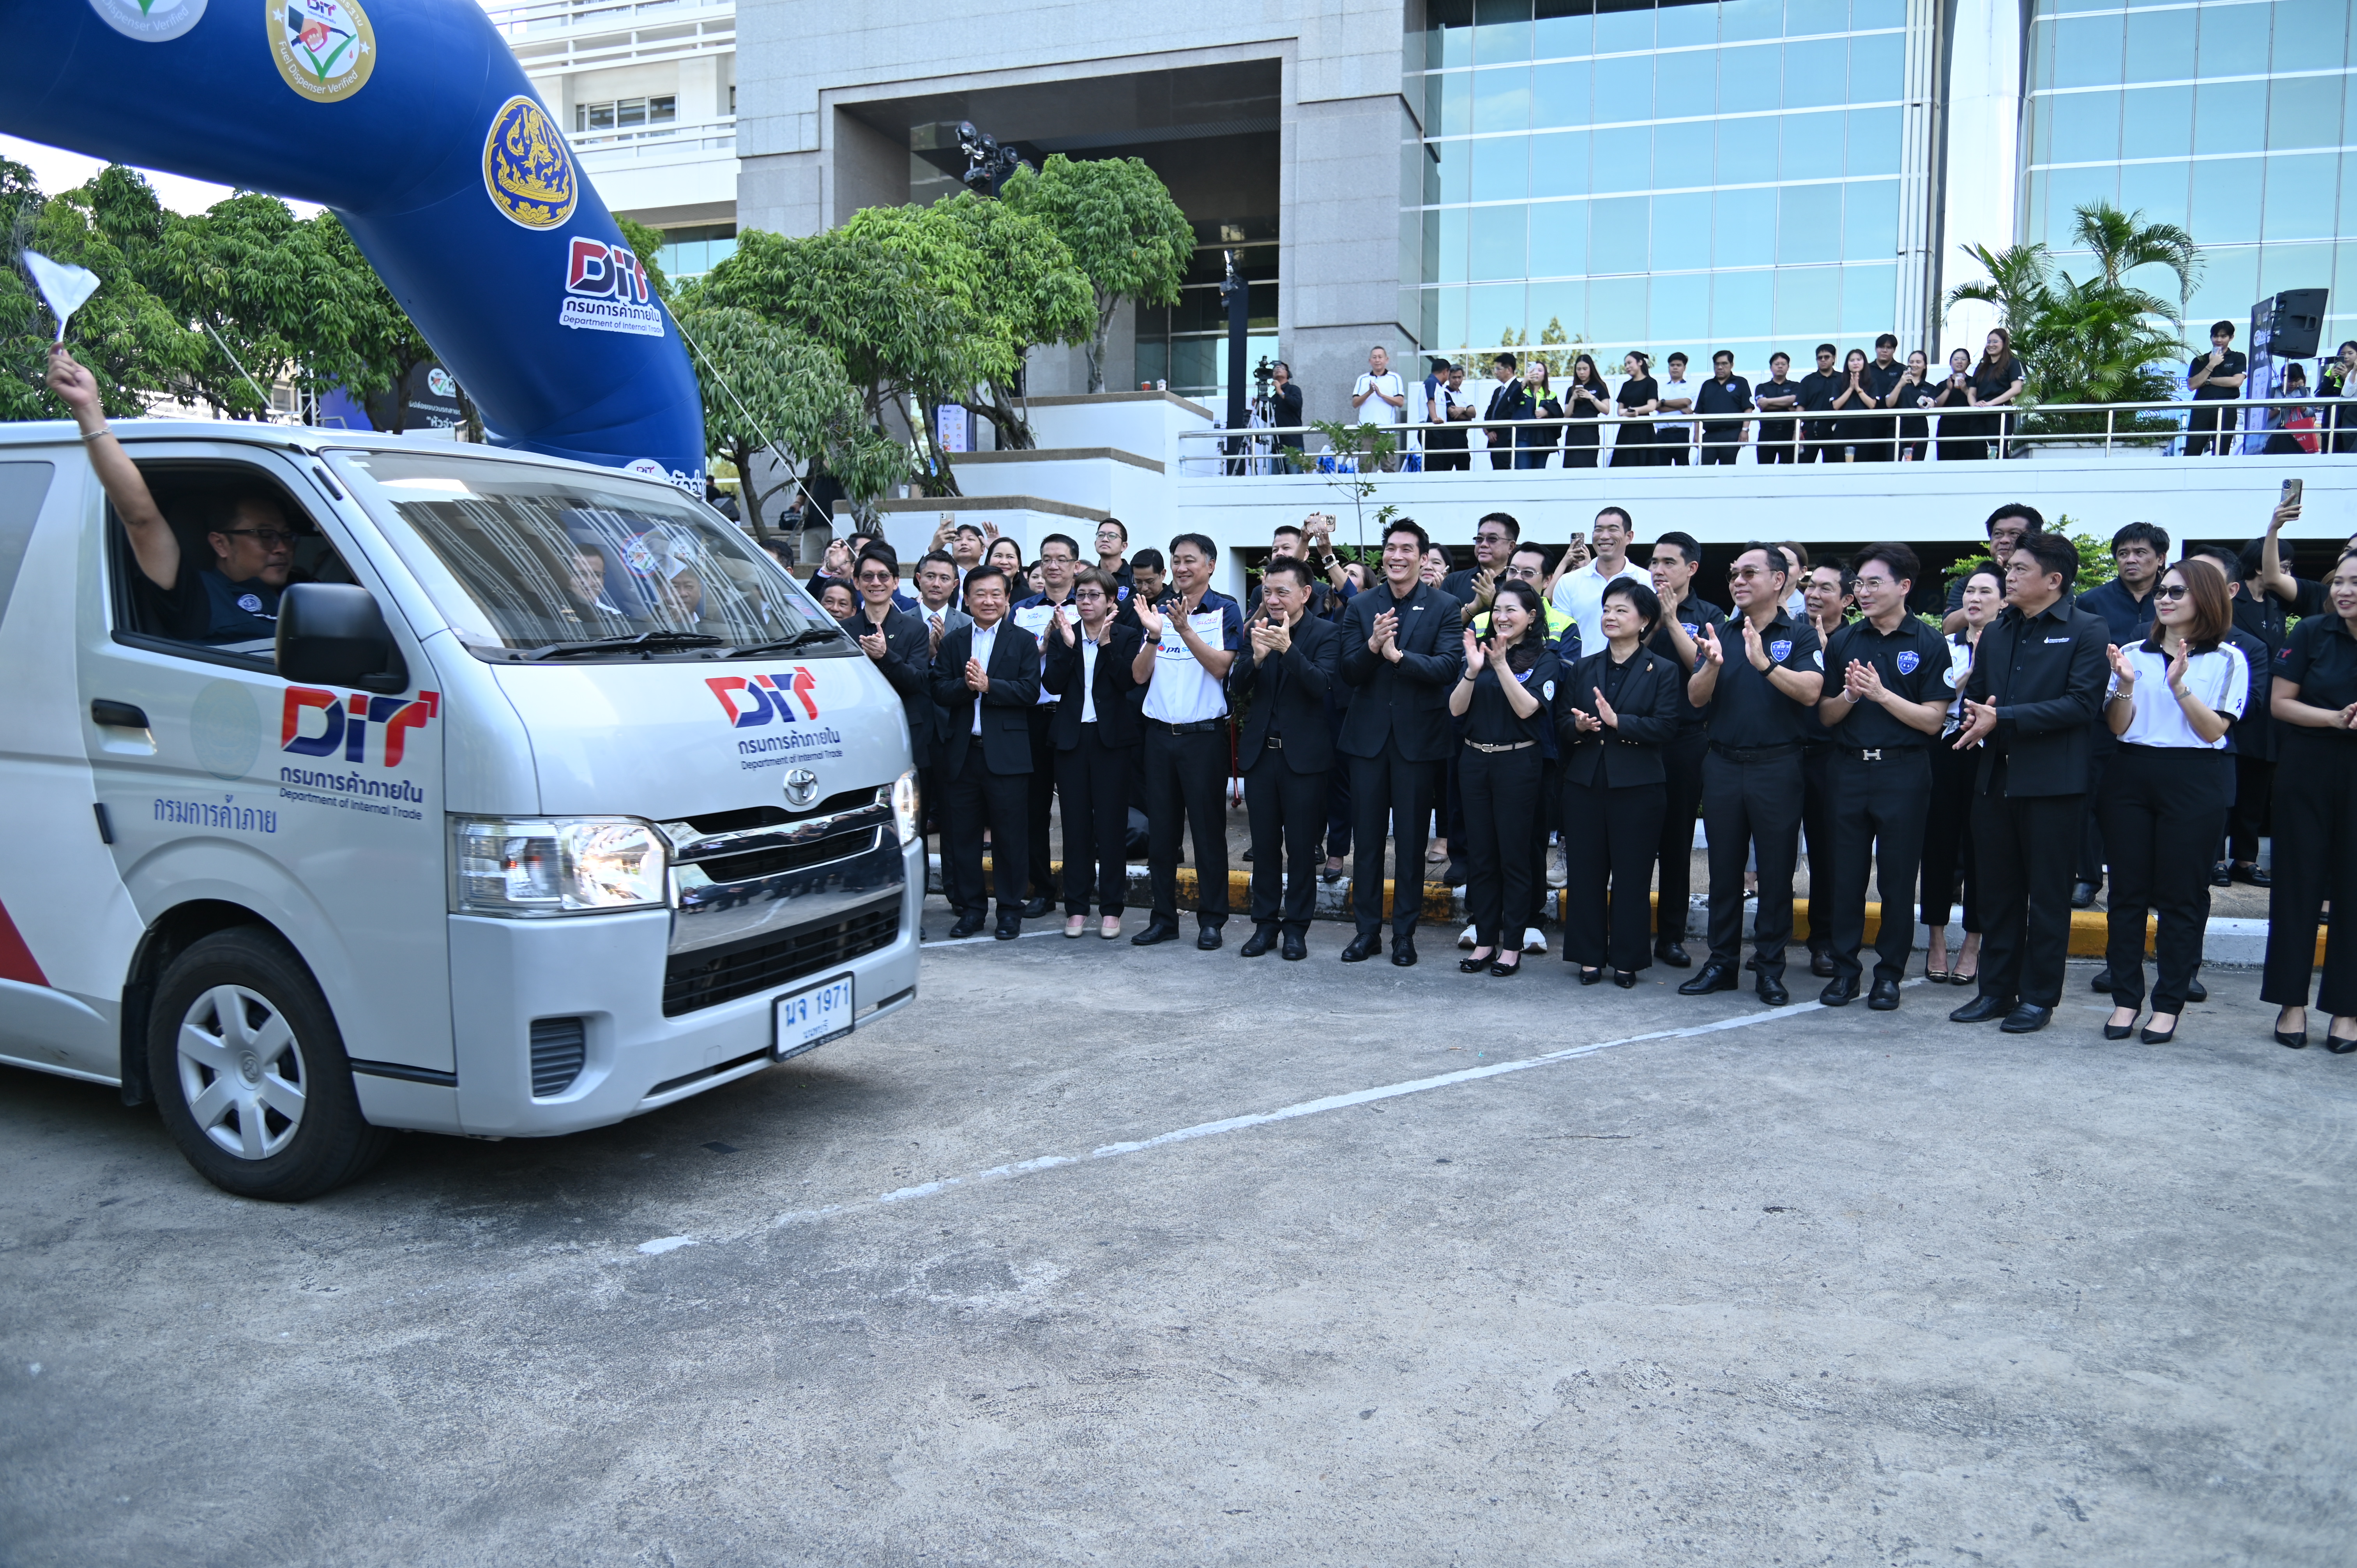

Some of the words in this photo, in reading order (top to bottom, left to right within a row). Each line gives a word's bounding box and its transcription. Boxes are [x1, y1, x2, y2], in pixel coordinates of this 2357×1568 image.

[153, 5, 189, 31] Verified
[340, 0, 364, 26] รฐาน
[279, 41, 293, 64] Fuel
[288, 64, 326, 94] Dispenser
[327, 69, 359, 94] Verified
[563, 315, 612, 328] Department
[623, 322, 647, 331] Internal
[566, 300, 660, 322] กรมการค้าภายใน
[1196, 617, 1218, 625] SUPER
[1899, 655, 1919, 663] CBWM
[738, 727, 841, 754] กรมการค้าภายใน
[741, 756, 788, 771] Department
[789, 754, 797, 763] of
[798, 752, 823, 762] Internal
[824, 749, 843, 758] Trade
[280, 766, 423, 804] กรมการค้าภายใน
[280, 788, 337, 807] Department
[339, 798, 349, 808] of
[350, 798, 390, 816] Internal
[392, 805, 422, 821] Trade
[816, 982, 849, 1014] 1971
